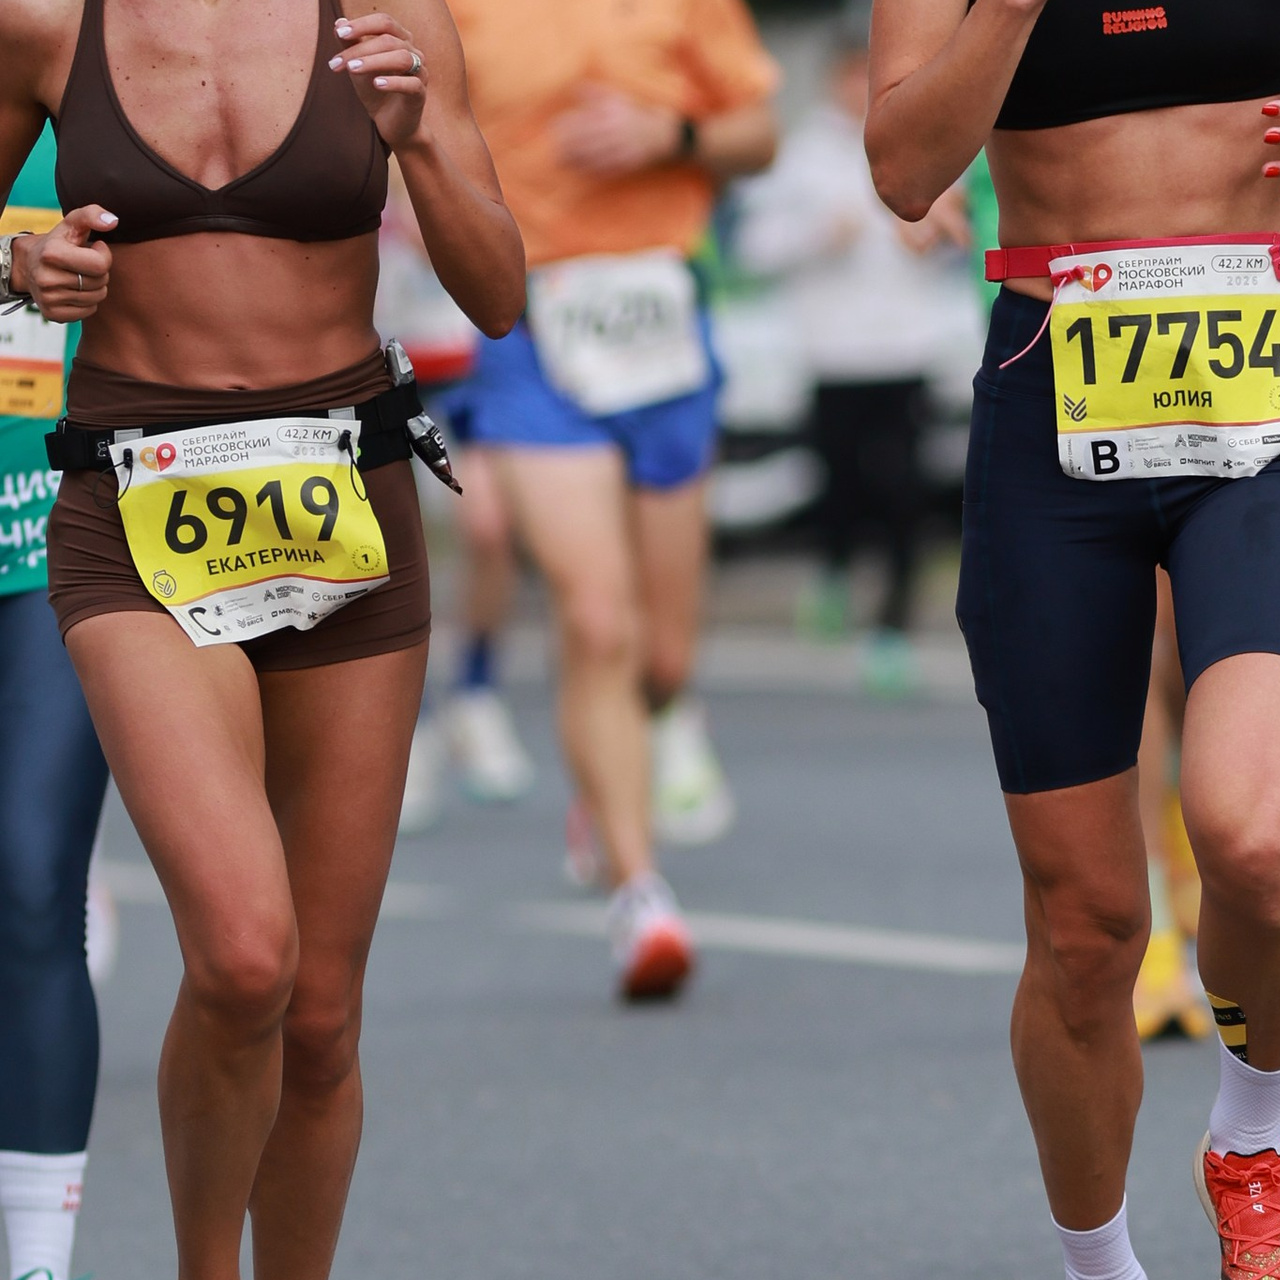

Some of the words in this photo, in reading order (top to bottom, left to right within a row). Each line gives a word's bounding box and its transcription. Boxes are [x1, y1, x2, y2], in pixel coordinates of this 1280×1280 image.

[1102, 6, 1166, 23] RUNNING
[1103, 18, 1168, 34] RELIGION
[1117, 257, 1182, 268] СБЕРПРАЙМ
[1218, 258, 1243, 270] 42,2
[1118, 264, 1206, 280] МОСКОВСКИЙ
[1118, 278, 1184, 291] МАРАФОН
[1153, 390, 1213, 408] ЮЛИЯ
[182, 430, 247, 447] СБЕРПРАЙМ
[285, 428, 309, 440] 42,2
[183, 437, 271, 458] МОСКОВСКИЙ
[184, 452, 250, 468] МАРАФОН
[164, 475, 340, 555] 6919
[206, 547, 325, 576] ЕКАТЕРИНА
[361, 553, 369, 564] 1
